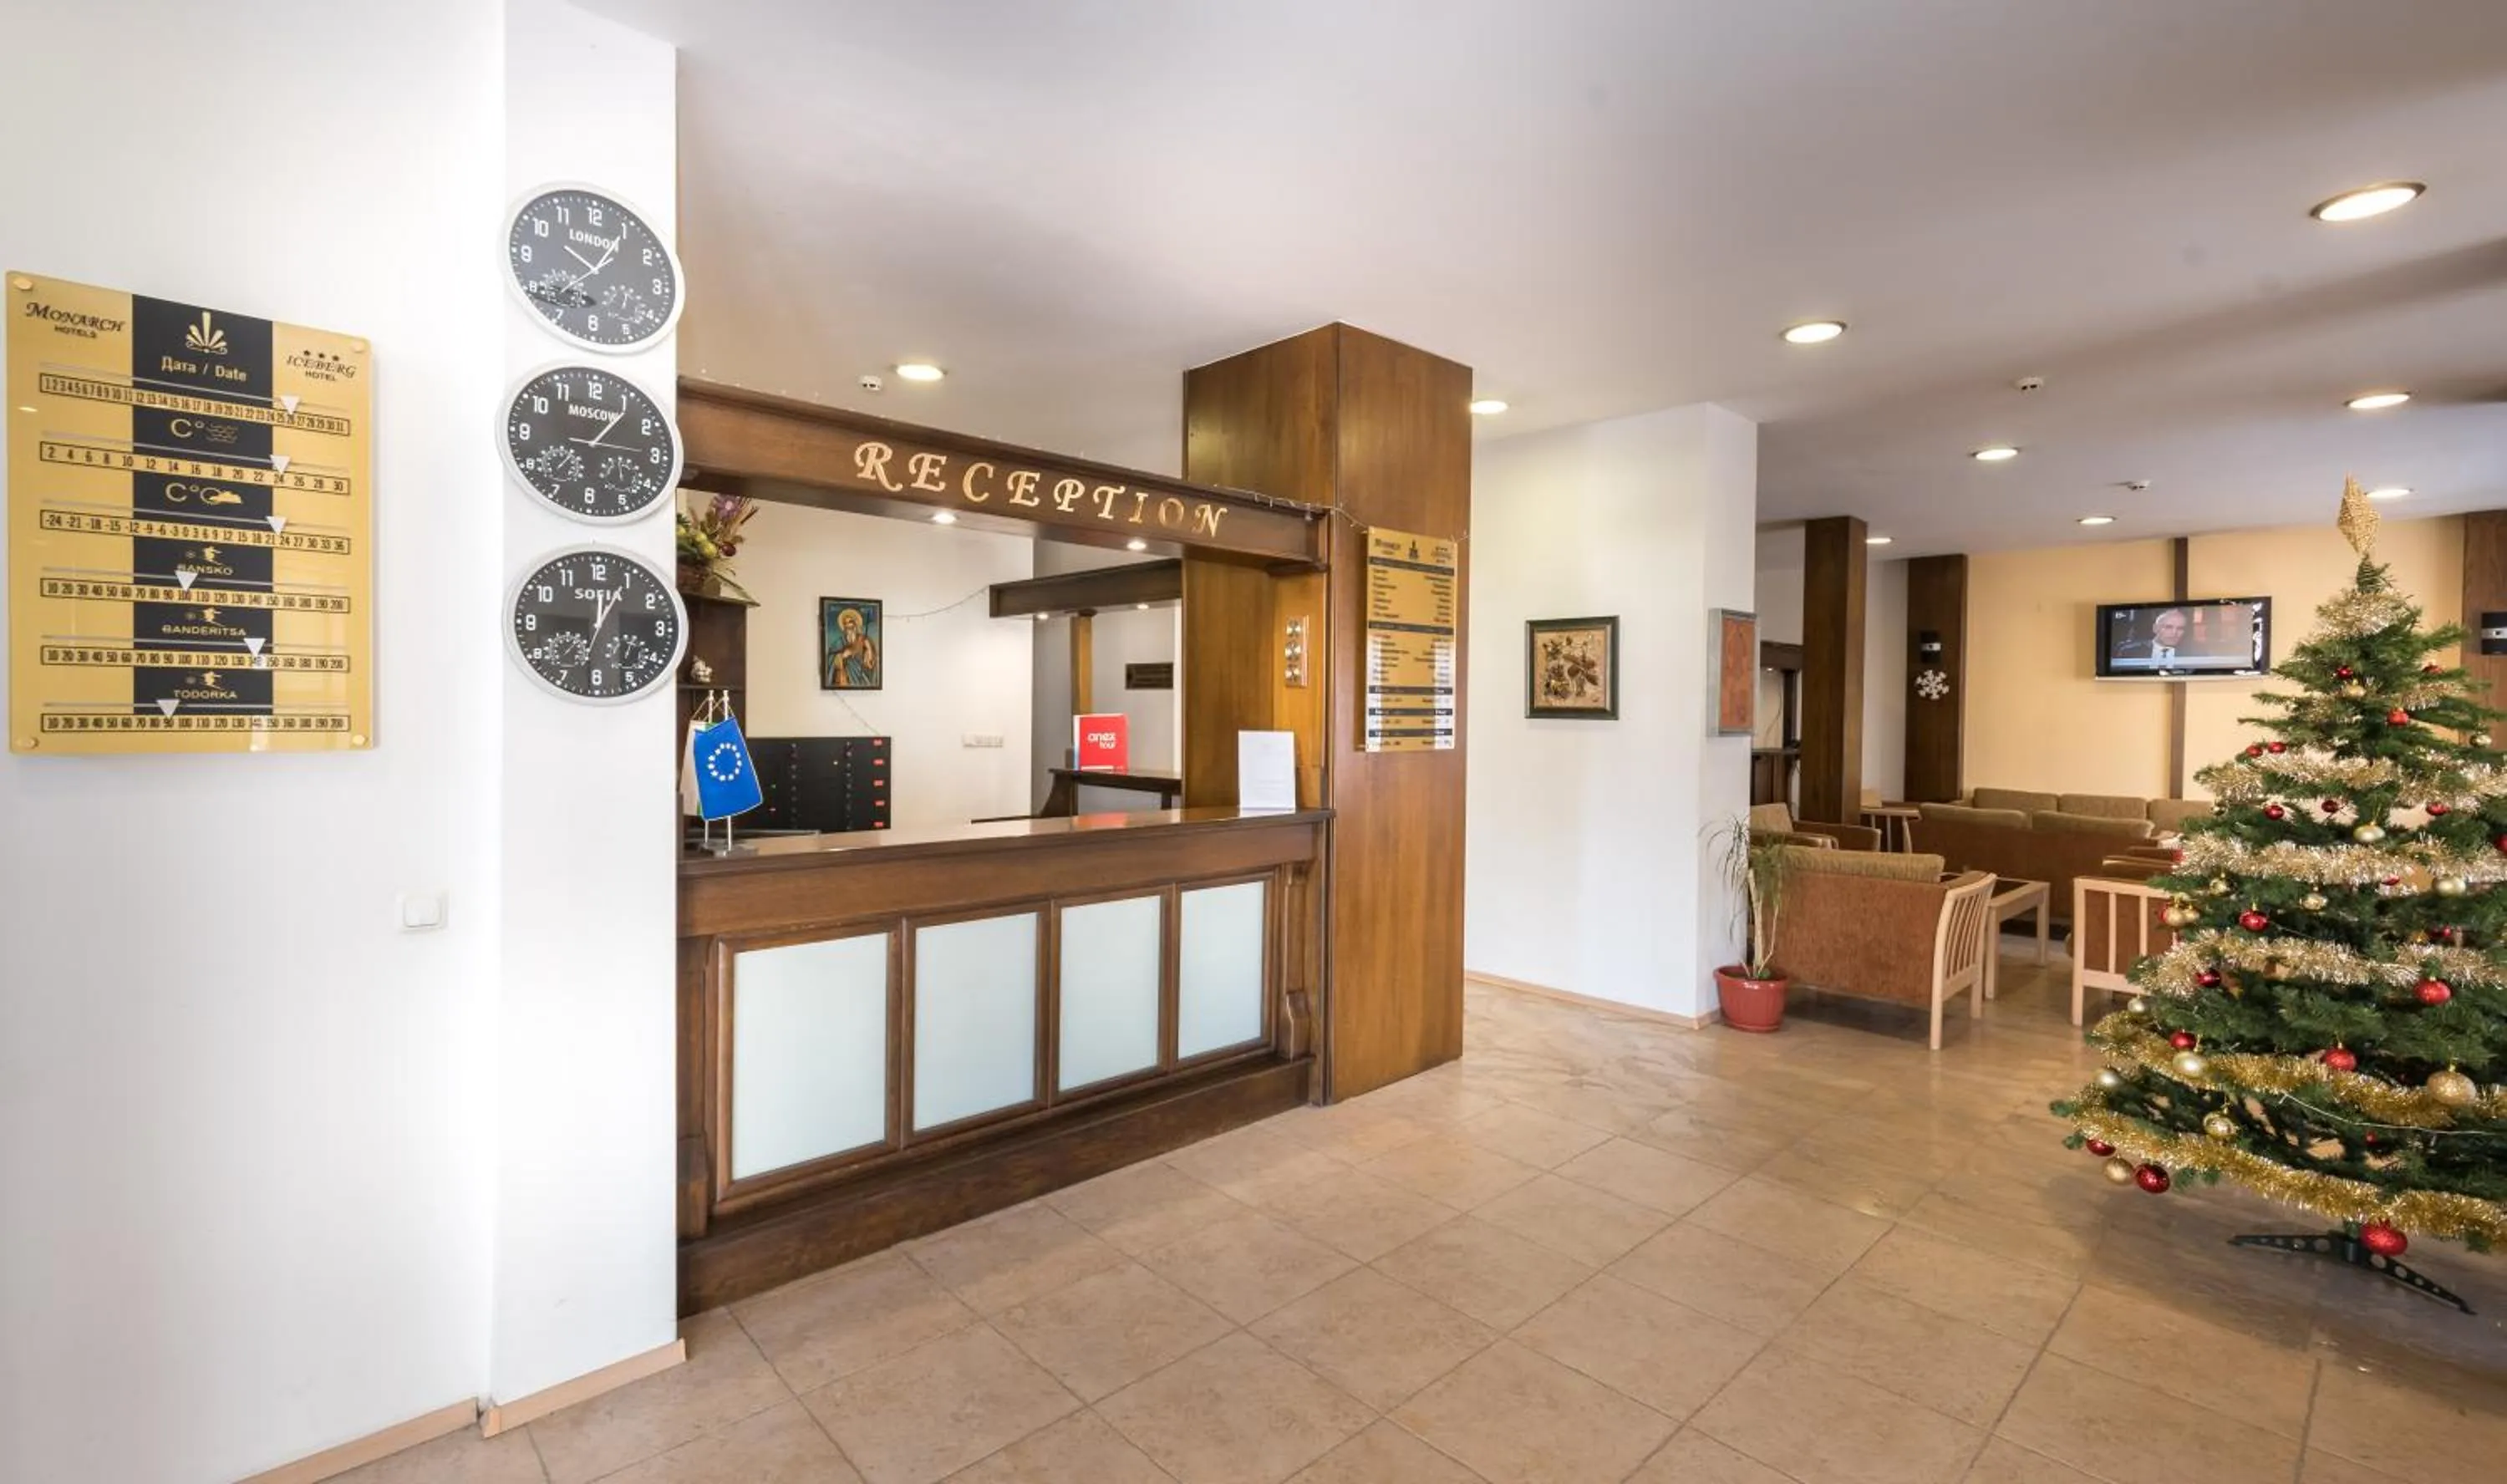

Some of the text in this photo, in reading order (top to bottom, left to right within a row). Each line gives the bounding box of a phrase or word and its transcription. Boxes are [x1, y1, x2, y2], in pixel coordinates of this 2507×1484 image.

[556, 206, 569, 226] 11
[587, 206, 603, 226] 12
[532, 218, 549, 237] 10
[621, 222, 627, 239] 1
[569, 228, 619, 253] LONDON
[643, 248, 653, 267] 2
[25, 302, 125, 333] MONARCH
[556, 309, 563, 319] 7
[587, 314, 598, 331] 6
[54, 325, 97, 338] HOTELS
[622, 323, 630, 334] 5
[161, 356, 197, 374] Дата
[215, 364, 247, 382] Date
[287, 354, 357, 379] ICEBERG
[305, 370, 338, 382] HOTEL
[556, 383, 569, 401] 11
[587, 381, 603, 400] 12
[532, 395, 549, 414] 10
[621, 394, 627, 411] 1
[568, 404, 620, 422] MOSCOW
[519, 423, 531, 440] 9
[641, 419, 651, 435] 2
[526, 458, 535, 470] 8
[650, 447, 660, 464] 3
[48, 446, 56, 459] 2
[68, 450, 74, 460] 4
[85, 450, 93, 462] 6
[104, 453, 110, 464] 8
[122, 455, 134, 467] 10
[146, 458, 156, 470] 12
[168, 460, 179, 472] 14
[191, 464, 201, 475] 16
[213, 465, 222, 477] 18
[232, 468, 243, 480] 20
[254, 470, 263, 482] 22
[294, 475, 305, 487] 26
[313, 478, 323, 489] 28
[333, 480, 343, 491] 30
[552, 484, 560, 495] 7
[643, 478, 651, 488] 4
[854, 441, 1227, 538] RECEPTION
[585, 487, 595, 504] 6
[618, 494, 626, 505] 5
[560, 569, 573, 587] 11
[590, 563, 607, 582] 12
[624, 573, 629, 589] 1
[536, 585, 553, 602] 10
[574, 587, 623, 602] SOFIA
[645, 593, 655, 609] 2
[161, 624, 247, 636] BANDERITSA
[526, 614, 536, 631] 9
[655, 621, 665, 637] 3
[533, 648, 542, 659] 8
[649, 652, 657, 662] 4
[559, 669, 567, 681] 7
[591, 669, 603, 685] 6
[625, 671, 633, 683] 5
[173, 689, 238, 699] TODORKA
